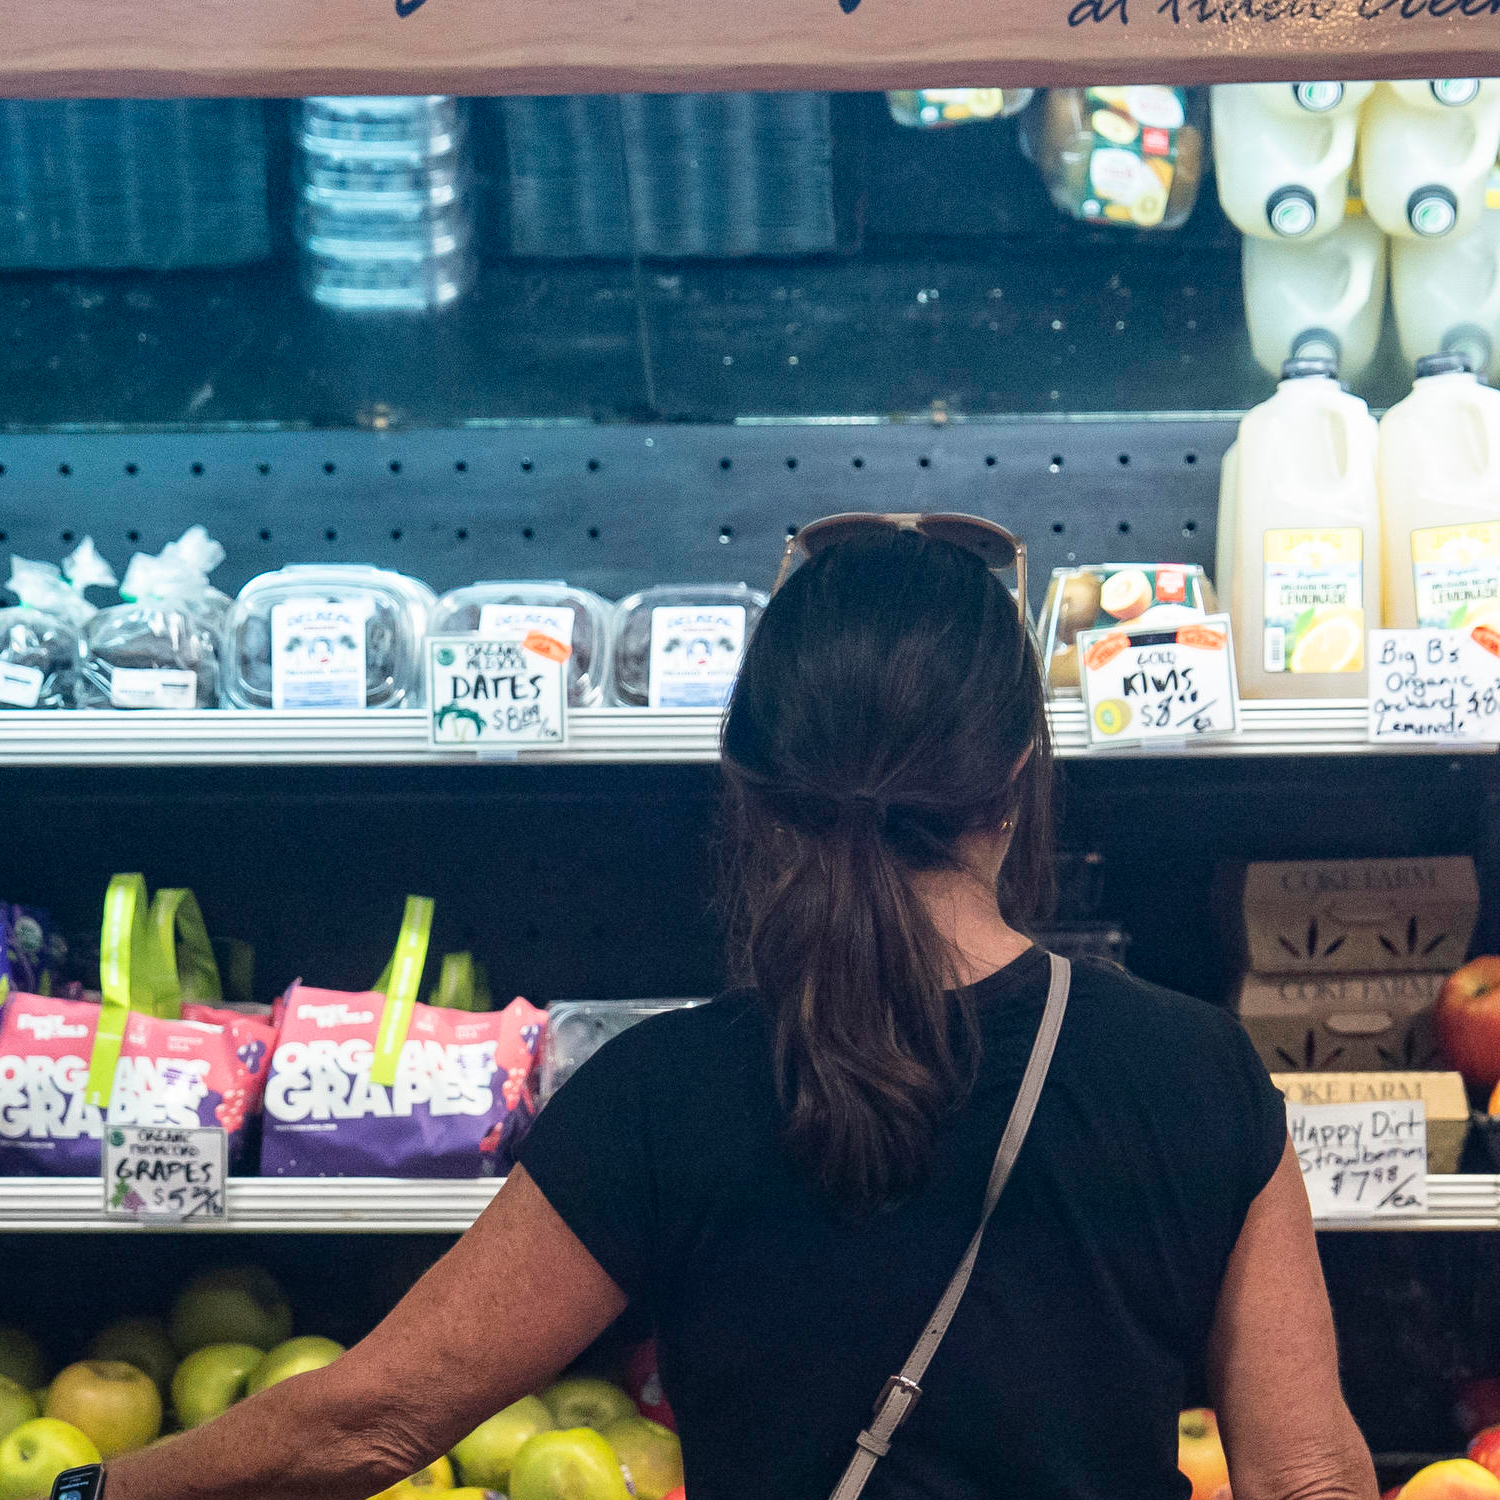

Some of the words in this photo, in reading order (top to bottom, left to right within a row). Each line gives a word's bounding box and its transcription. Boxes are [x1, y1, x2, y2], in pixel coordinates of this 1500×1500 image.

[1378, 639, 1418, 676] Big
[451, 674, 544, 700] DATES
[1123, 667, 1193, 697] KIWIS
[1386, 671, 1474, 698] Organic
[263, 1071, 494, 1122] GRAPES
[1349, 1081, 1423, 1102] FARM
[1372, 1109, 1424, 1139] Dirt
[115, 1157, 214, 1182] GRAPES
